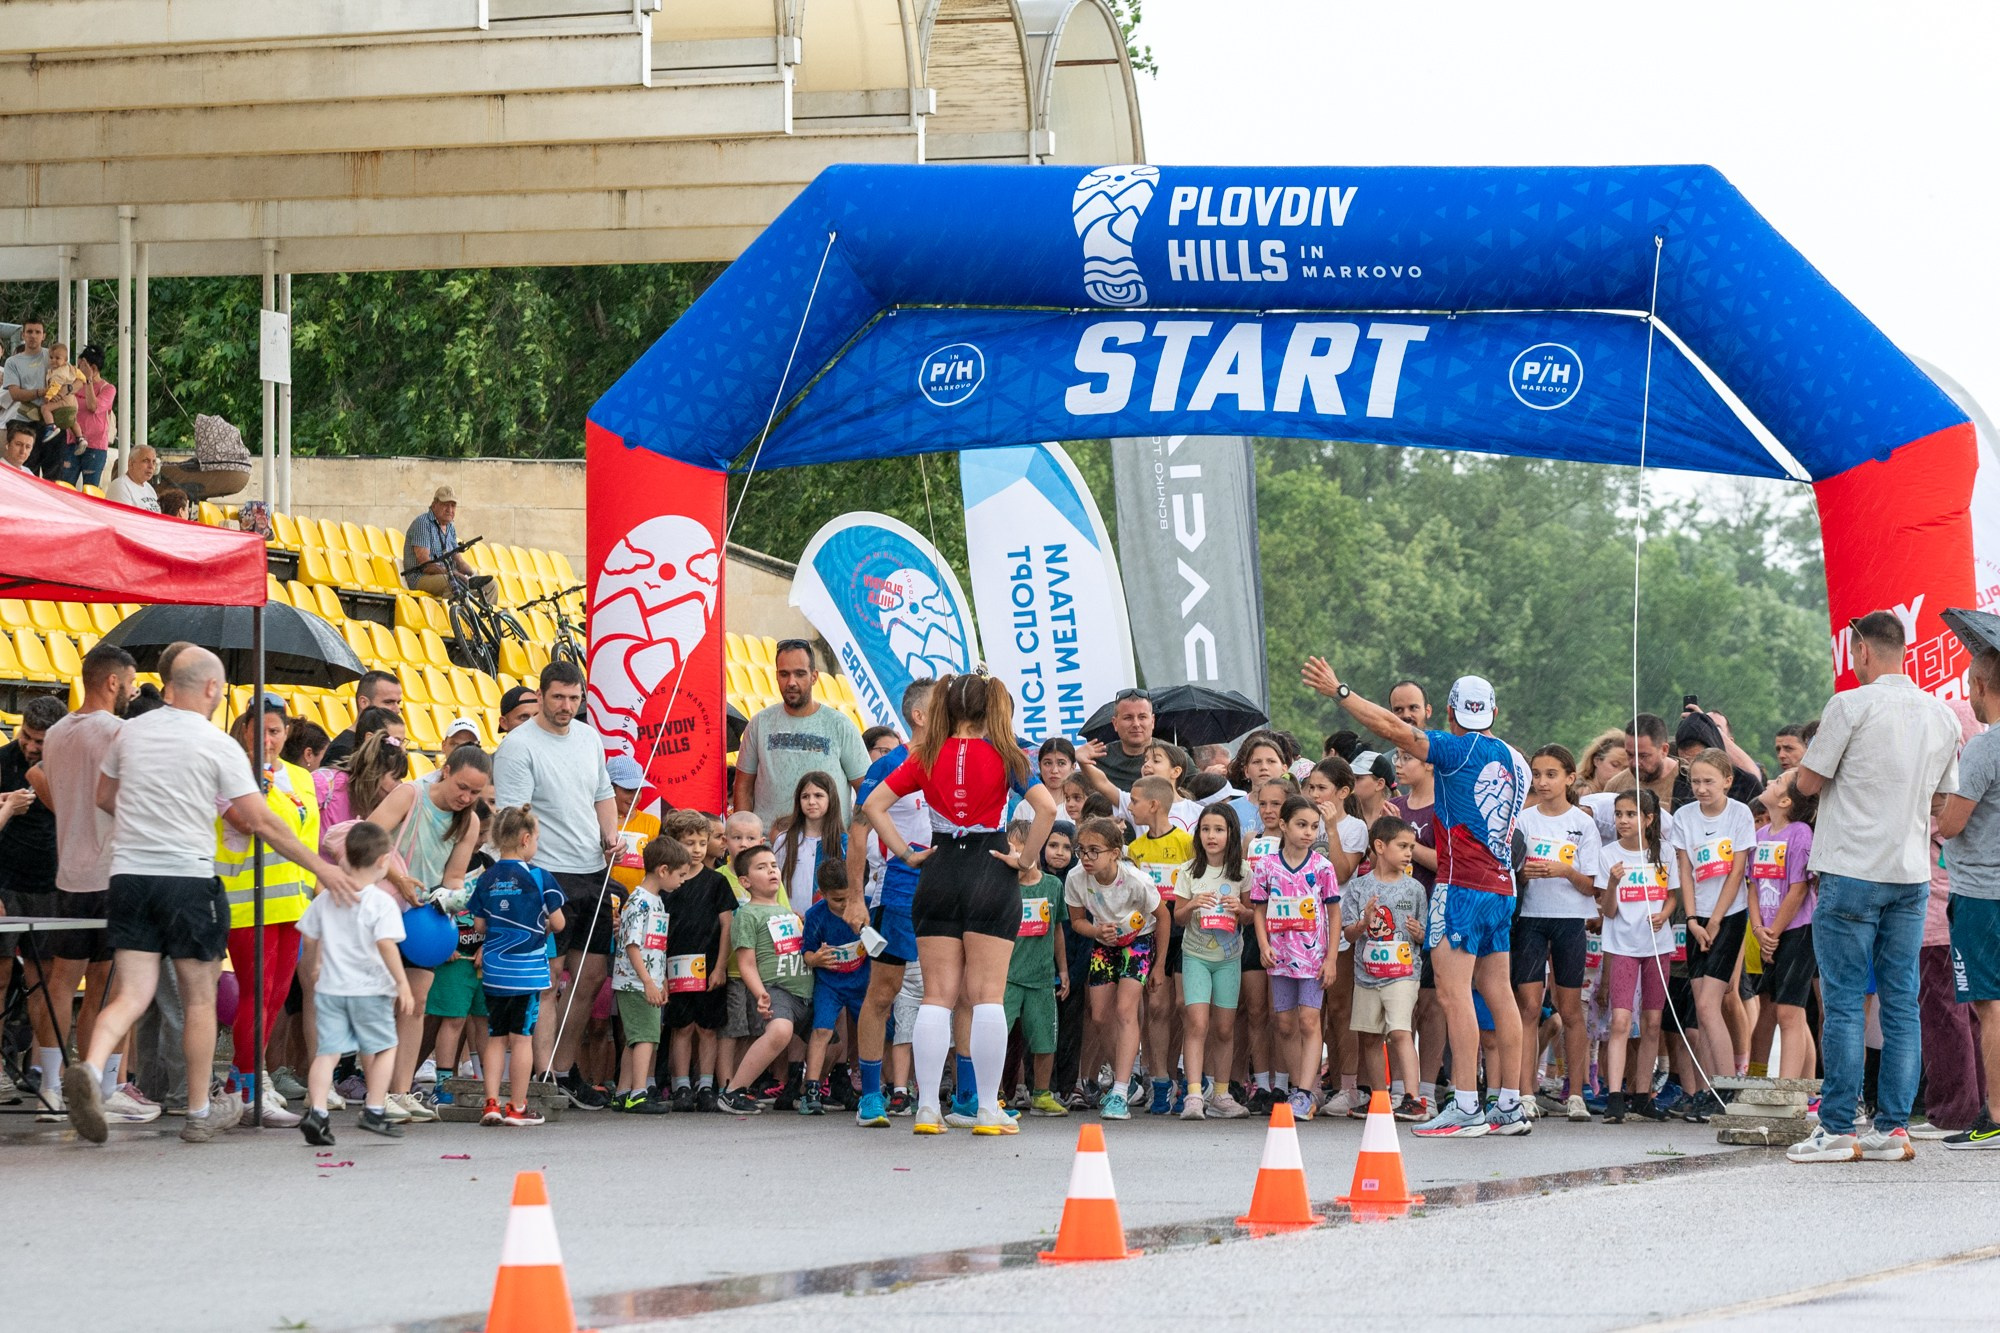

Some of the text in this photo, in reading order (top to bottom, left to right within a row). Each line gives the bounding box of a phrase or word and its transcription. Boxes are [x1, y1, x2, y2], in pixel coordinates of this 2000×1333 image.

[1168, 186, 1358, 226] PLOVDIV
[1300, 245, 1324, 260] IN
[1168, 239, 1289, 282] HILLS
[1302, 265, 1423, 279] MARKOVO
[930, 360, 974, 383] P/H
[1064, 319, 1430, 420] START
[1522, 361, 1571, 384] P/H
[930, 383, 971, 392] MARKOVO
[1520, 384, 1568, 394] MARKOVO
[1903, 629, 1969, 688] TEP
[637, 716, 696, 741] PLOVDIV
[651, 736, 691, 757] HILLS
[668, 775, 688, 785] RUN
[691, 753, 708, 776] RACE
[1513, 764, 1525, 818] MATTERS
[1254, 843, 1270, 855] 61
[1534, 843, 1551, 856] 47
[1697, 848, 1710, 863] 48
[1758, 849, 1769, 861] 97
[1628, 871, 1647, 884] 46
[1276, 904, 1290, 916] 11
[655, 919, 667, 933] 36
[779, 923, 794, 937] 27
[1370, 948, 1389, 961] 60
[673, 962, 679, 976] 1
[1953, 961, 1969, 991] NIKE
